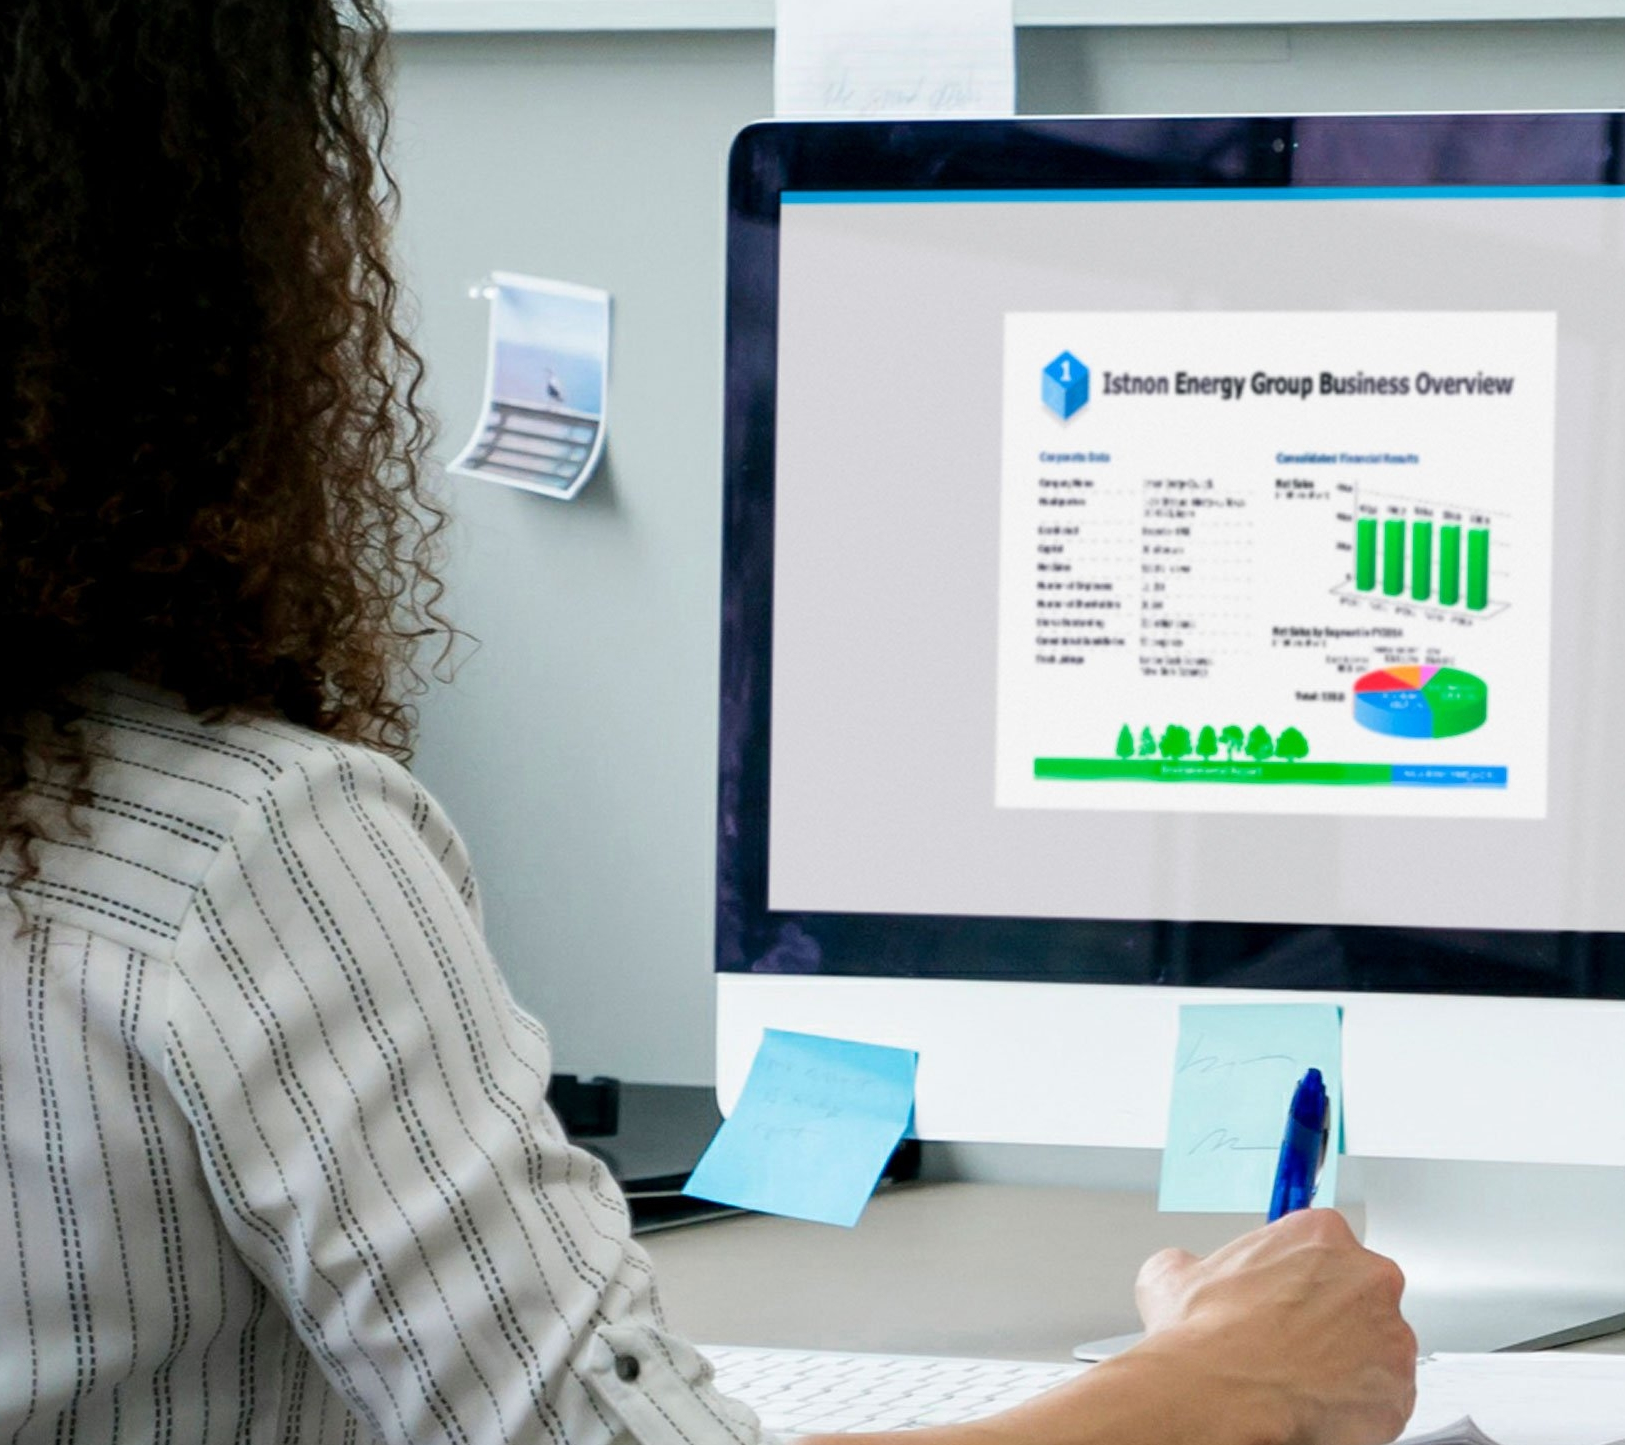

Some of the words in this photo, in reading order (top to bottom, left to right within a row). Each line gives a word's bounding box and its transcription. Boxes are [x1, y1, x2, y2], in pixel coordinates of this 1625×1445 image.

[1103, 371, 1169, 394] Istnon
[1175, 371, 1245, 401] Energy
[1251, 371, 1313, 400] Group
[1319, 371, 1410, 395] Business
[1415, 371, 1514, 395] Overview
